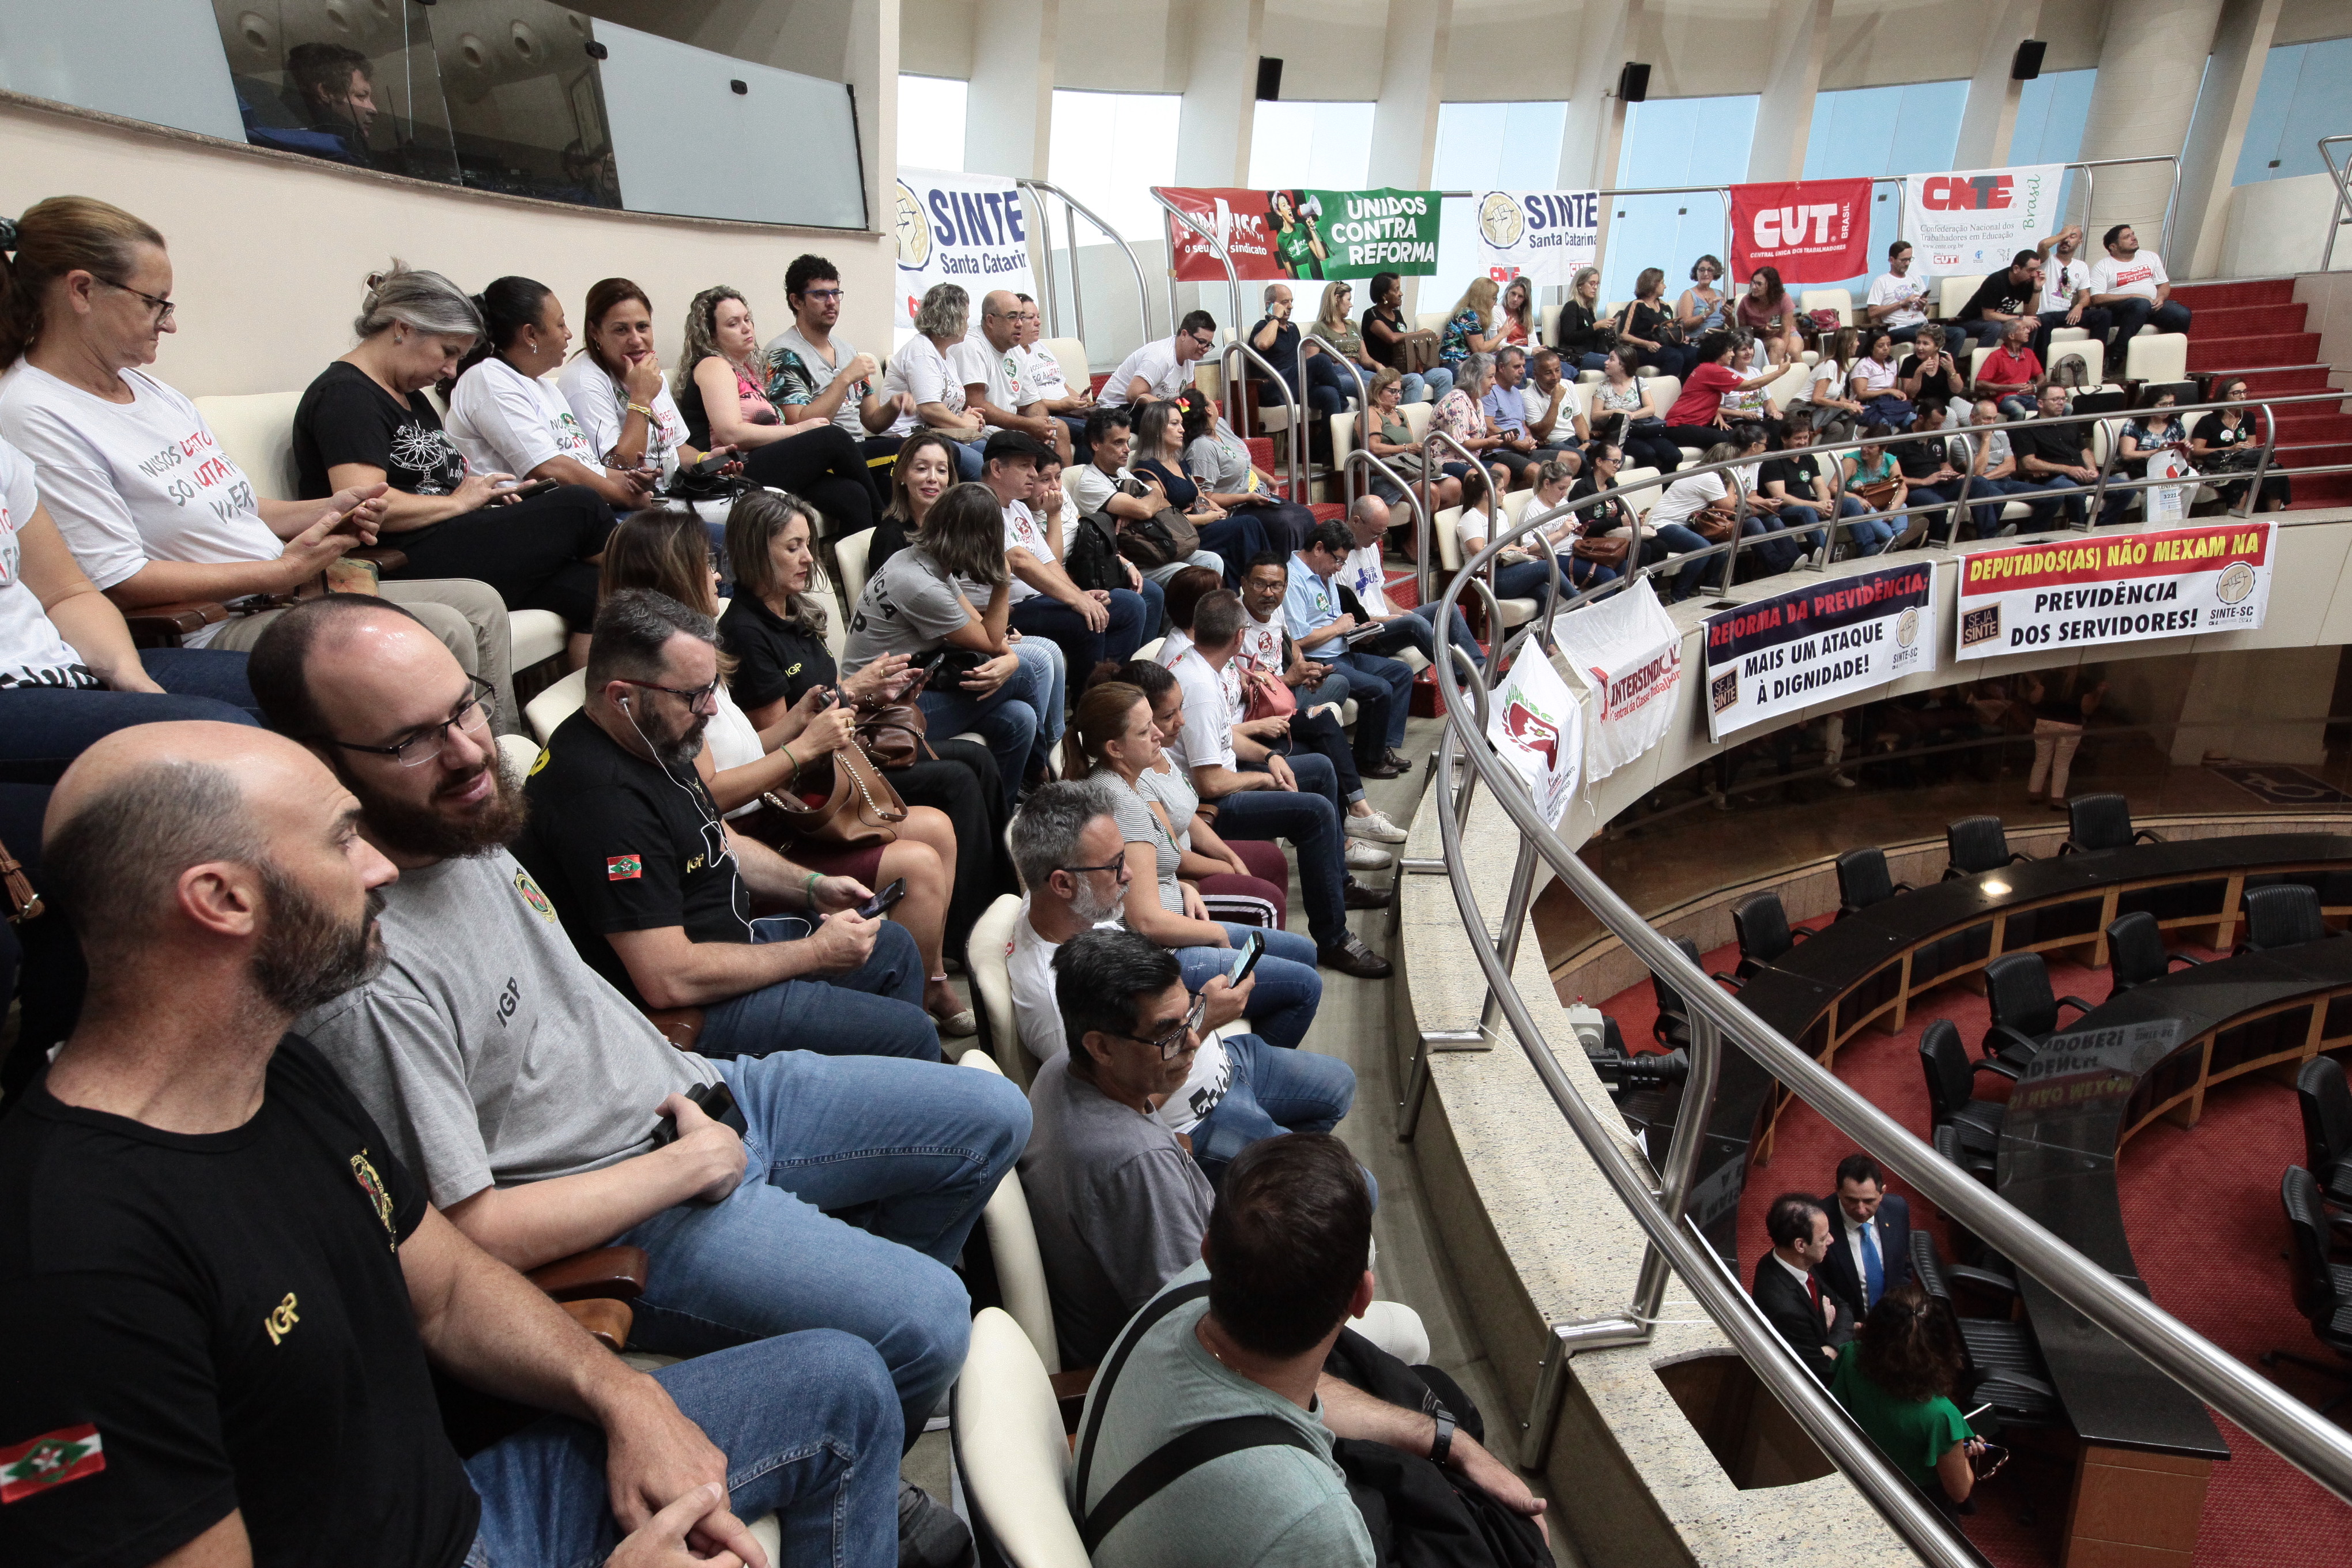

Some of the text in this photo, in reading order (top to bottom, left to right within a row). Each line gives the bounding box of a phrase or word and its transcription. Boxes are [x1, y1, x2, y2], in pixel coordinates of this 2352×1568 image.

[1922, 175, 2014, 210] CNTE
[2023, 174, 2041, 229] Brasil
[929, 189, 1025, 247] SINTE
[1348, 197, 1427, 220] UNIDOS
[1524, 192, 1597, 229] SINTE
[1841, 202, 1849, 239] BRASIL
[1332, 217, 1416, 243] CONTRA
[1754, 203, 1837, 248] CUT
[1920, 224, 1967, 233] Confederação
[1970, 223, 2000, 231] Nacional
[1921, 233, 1967, 242] Trabalhadores
[1981, 232, 2013, 240] Educação
[1185, 242, 1267, 255] o seu sindicato
[1529, 232, 1562, 248] Santa
[1750, 249, 1774, 258] CENTRAL
[1776, 248, 1791, 256] ÚNICA
[1804, 244, 1846, 253] TRABALHADORES
[940, 254, 979, 274] Santa
[1349, 242, 1435, 266] REFORMA
[1970, 533, 2259, 581] DEPUTADOS(AS) NÃO MEXAM NA
[2034, 581, 2177, 613] PREVIDÊNCIA
[1710, 573, 1928, 647] REFORMA DA PREVIDÊNCIA:
[1968, 610, 1993, 628] SEJA
[2210, 606, 2253, 619] SINTE-SC
[1965, 621, 1997, 643] SINTE
[2011, 608, 2198, 647] DOS SERVIDORES!
[1744, 622, 1883, 679] MAIS UM ATAQUE
[1893, 647, 1918, 664] SINTE-SC
[785, 662, 802, 678] IGP
[1757, 654, 1869, 705] À DIGNIDADE!
[1715, 674, 1733, 696] SEJA
[1636, 692, 1650, 708] Classe
[1713, 685, 1736, 712] SINTE
[687, 853, 704, 873] IGP
[496, 976, 521, 1028] IGP
[264, 1292, 300, 1346] IGP
